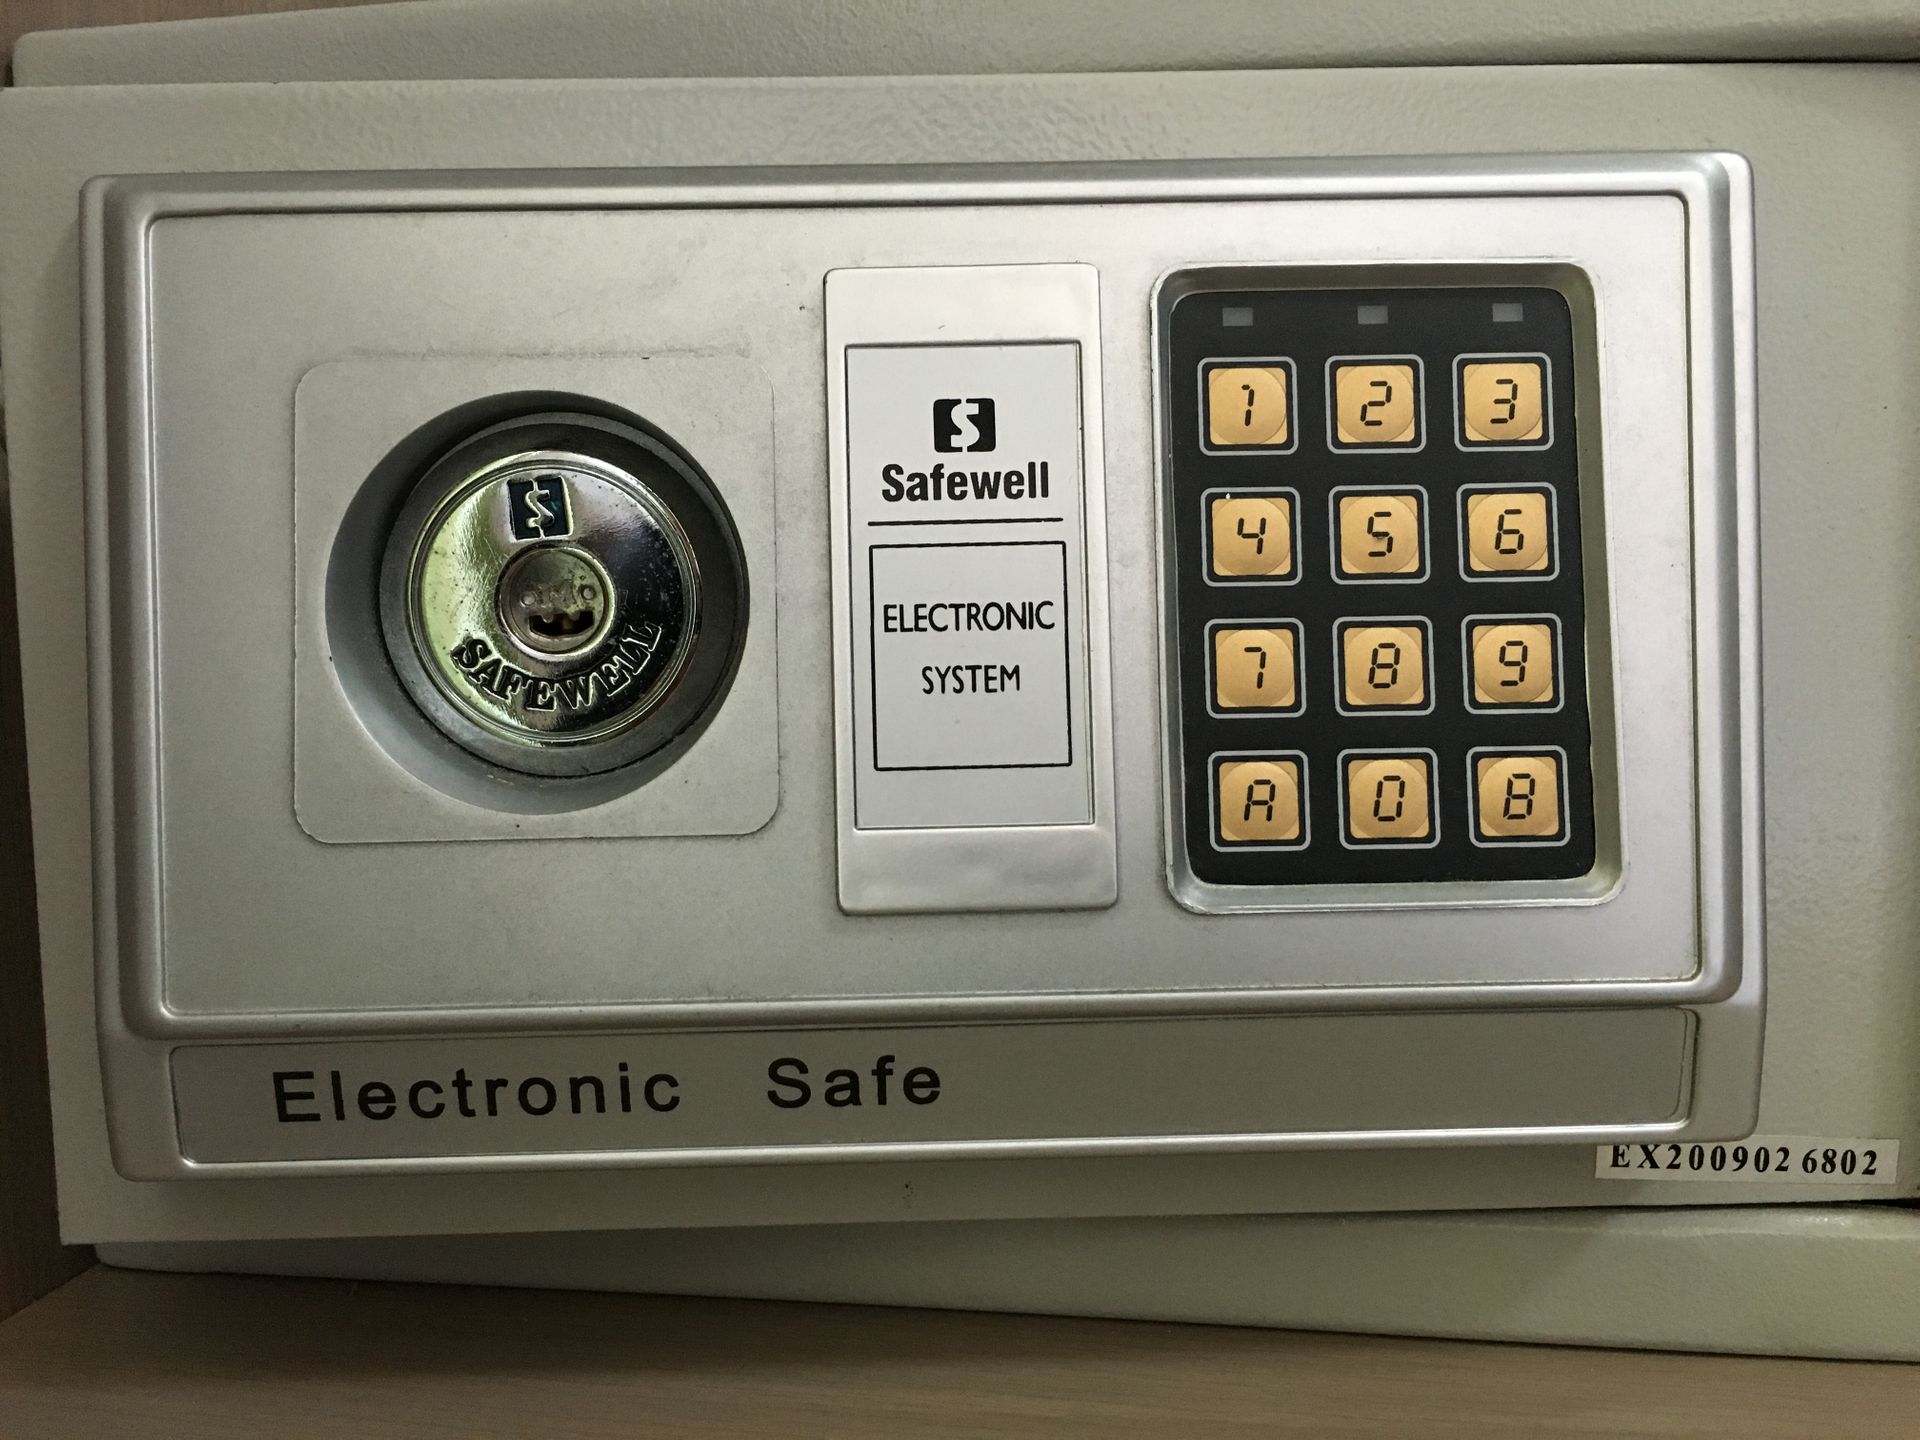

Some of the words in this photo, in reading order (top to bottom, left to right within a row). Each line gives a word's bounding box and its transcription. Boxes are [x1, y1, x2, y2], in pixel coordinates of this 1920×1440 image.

[1359, 380, 1393, 427] 2
[1489, 378, 1518, 425] 3
[881, 461, 1049, 502] Safewell
[1236, 517, 1267, 555] 4
[1366, 511, 1394, 558] 5
[1494, 508, 1525, 555] 6
[883, 601, 1055, 633] ELECTRONIC
[450, 620, 662, 712] SAFEWELL
[921, 664, 1021, 695] SYSTEM
[1243, 646, 1267, 690] 7
[1367, 642, 1401, 690] 8
[1498, 640, 1528, 688] 9
[1243, 778, 1276, 823] A
[1372, 775, 1406, 823] 0
[271, 1062, 681, 1123] Electronic
[766, 1054, 941, 1110] Safe
[1609, 1143, 1791, 1173] EX200902
[1801, 1148, 1878, 1176] 6802
